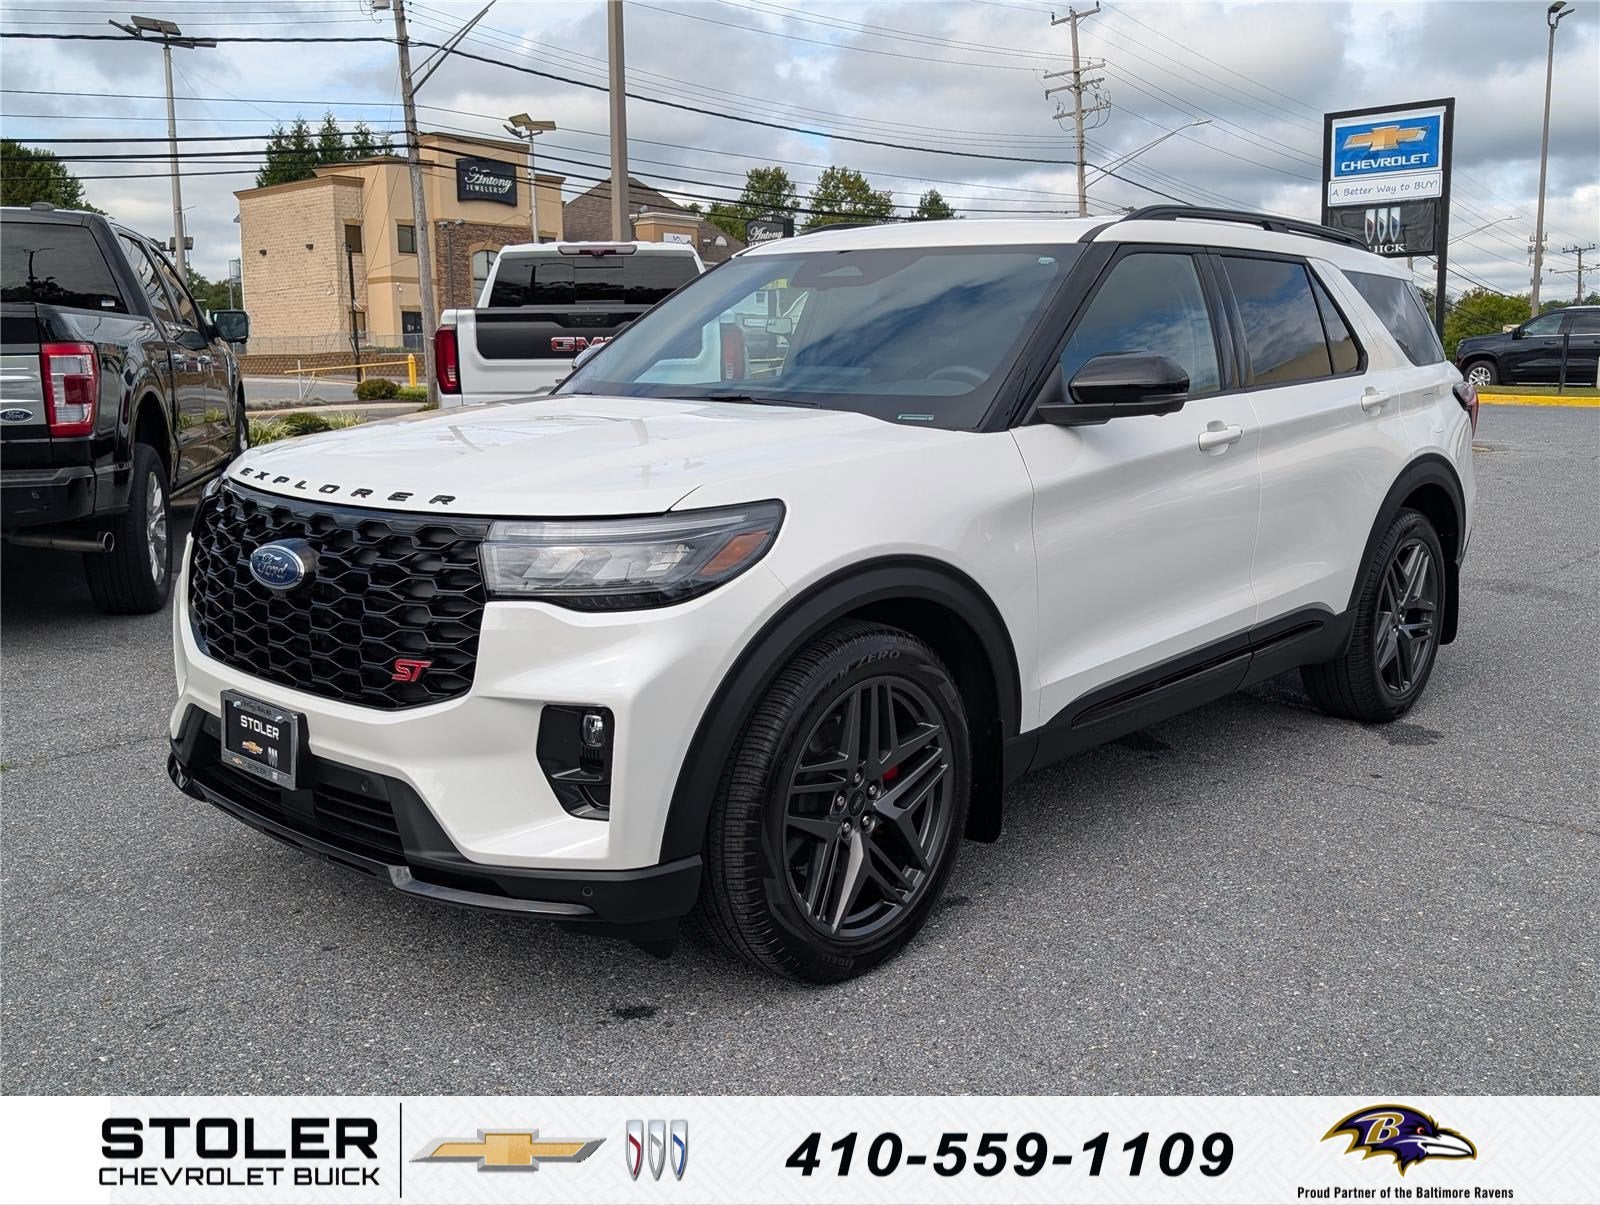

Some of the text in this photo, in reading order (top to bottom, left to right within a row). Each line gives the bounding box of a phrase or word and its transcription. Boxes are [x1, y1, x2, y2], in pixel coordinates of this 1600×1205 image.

[1341, 153, 1429, 172] CHEVROLET
[464, 166, 512, 194] Antony
[466, 184, 503, 194] JEWELERS
[1331, 179, 1438, 198] A Better Way to BUY!
[551, 336, 613, 352] GM
[5, 410, 25, 420] Ford
[239, 467, 456, 505] EXPLORER
[256, 552, 289, 580] Ford
[391, 658, 432, 682] ST
[240, 714, 280, 740] STOLER
